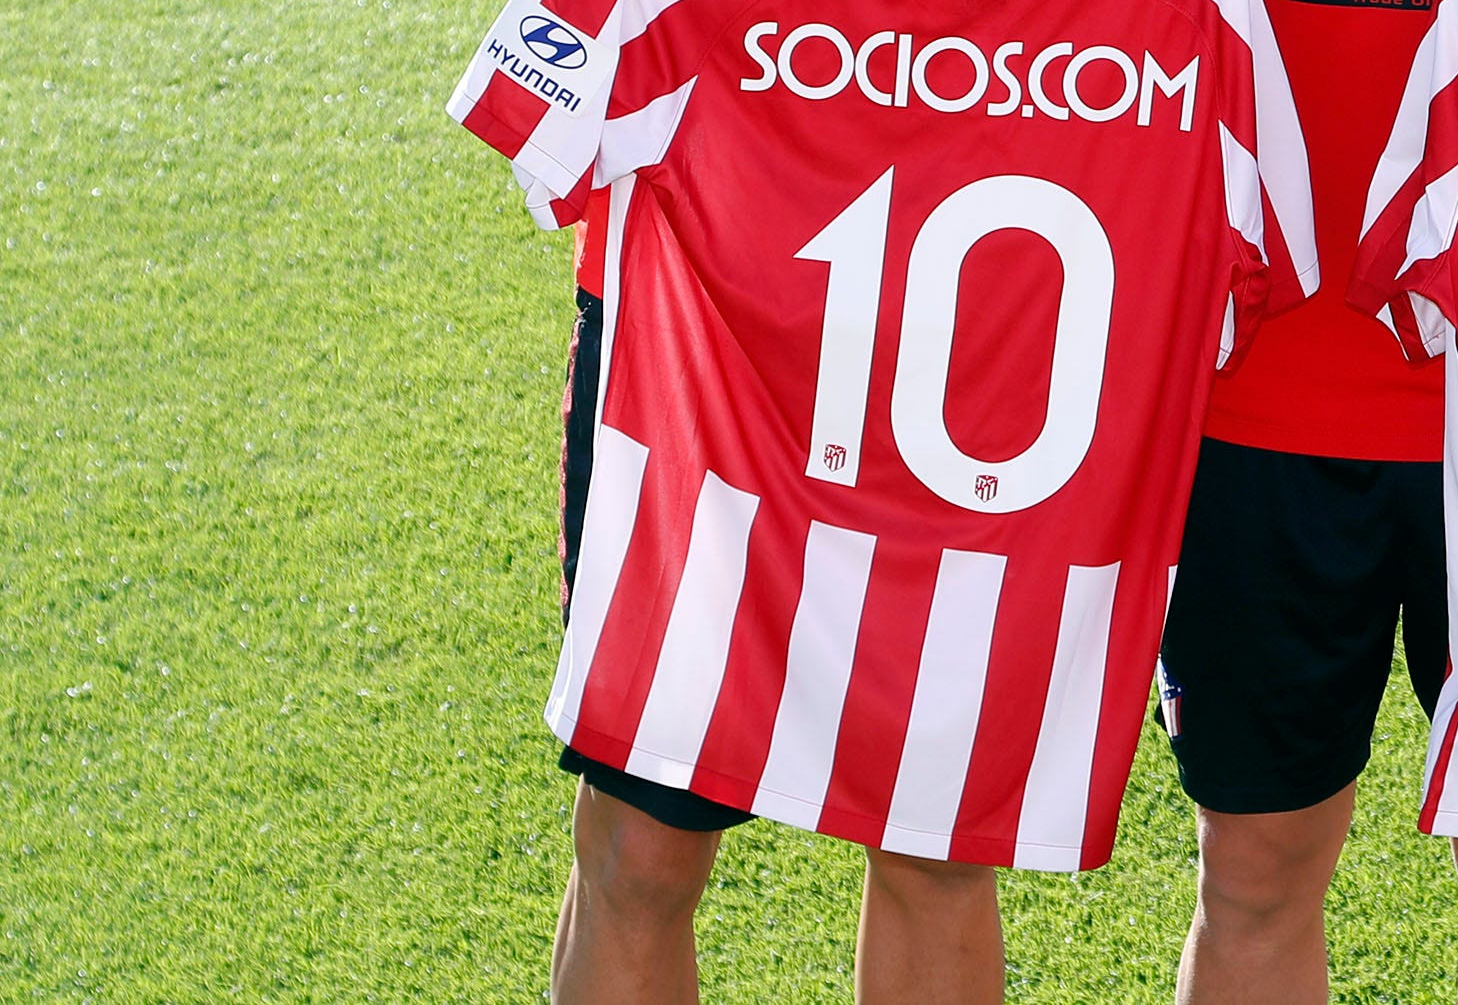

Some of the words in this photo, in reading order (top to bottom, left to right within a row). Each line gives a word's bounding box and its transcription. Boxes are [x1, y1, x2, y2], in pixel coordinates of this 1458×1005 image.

[487, 39, 582, 112] HYUNDAI
[740, 21, 1200, 132] SOCIOS.COM
[793, 165, 1116, 514] 10
